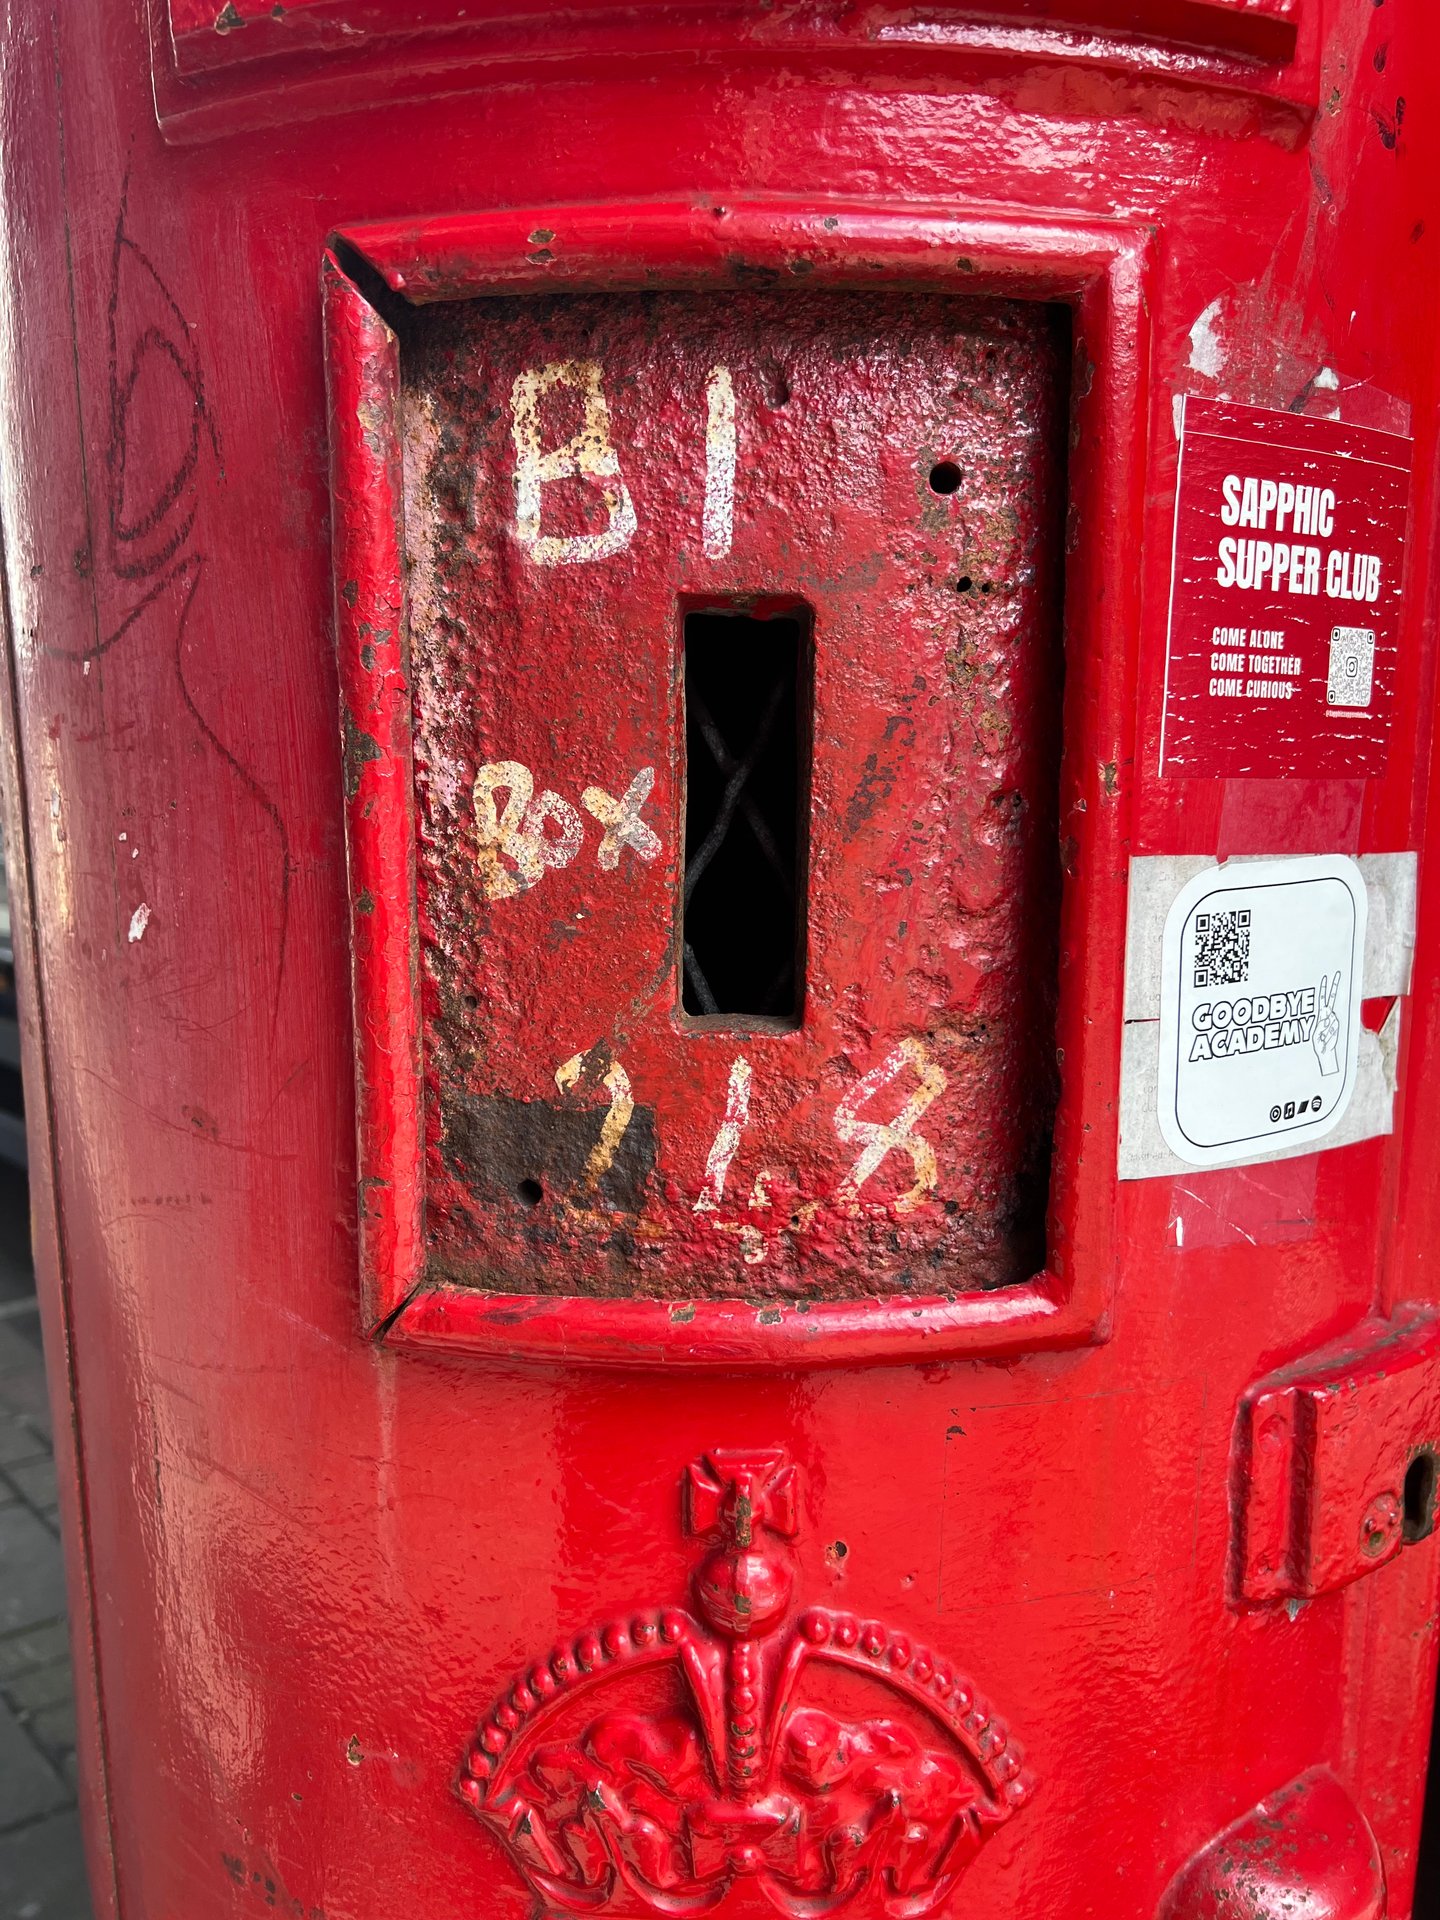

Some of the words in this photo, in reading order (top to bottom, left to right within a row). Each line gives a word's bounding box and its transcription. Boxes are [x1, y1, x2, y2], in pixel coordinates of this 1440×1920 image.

[1221, 474, 1335, 538] SAPPHIC
[1217, 536, 1321, 596] SUPPER
[1326, 549, 1381, 603] CLUB
[1212, 626, 1247, 647] COME
[1249, 629, 1285, 650] ALONE
[1210, 652, 1245, 673] COME
[1248, 654, 1302, 676] TOGETHER
[1208, 677, 1243, 698] COME
[1246, 679, 1293, 700] CURIOUS
[1192, 987, 1316, 1031] GOODBYE
[1189, 1015, 1316, 1062] ACADEMY
